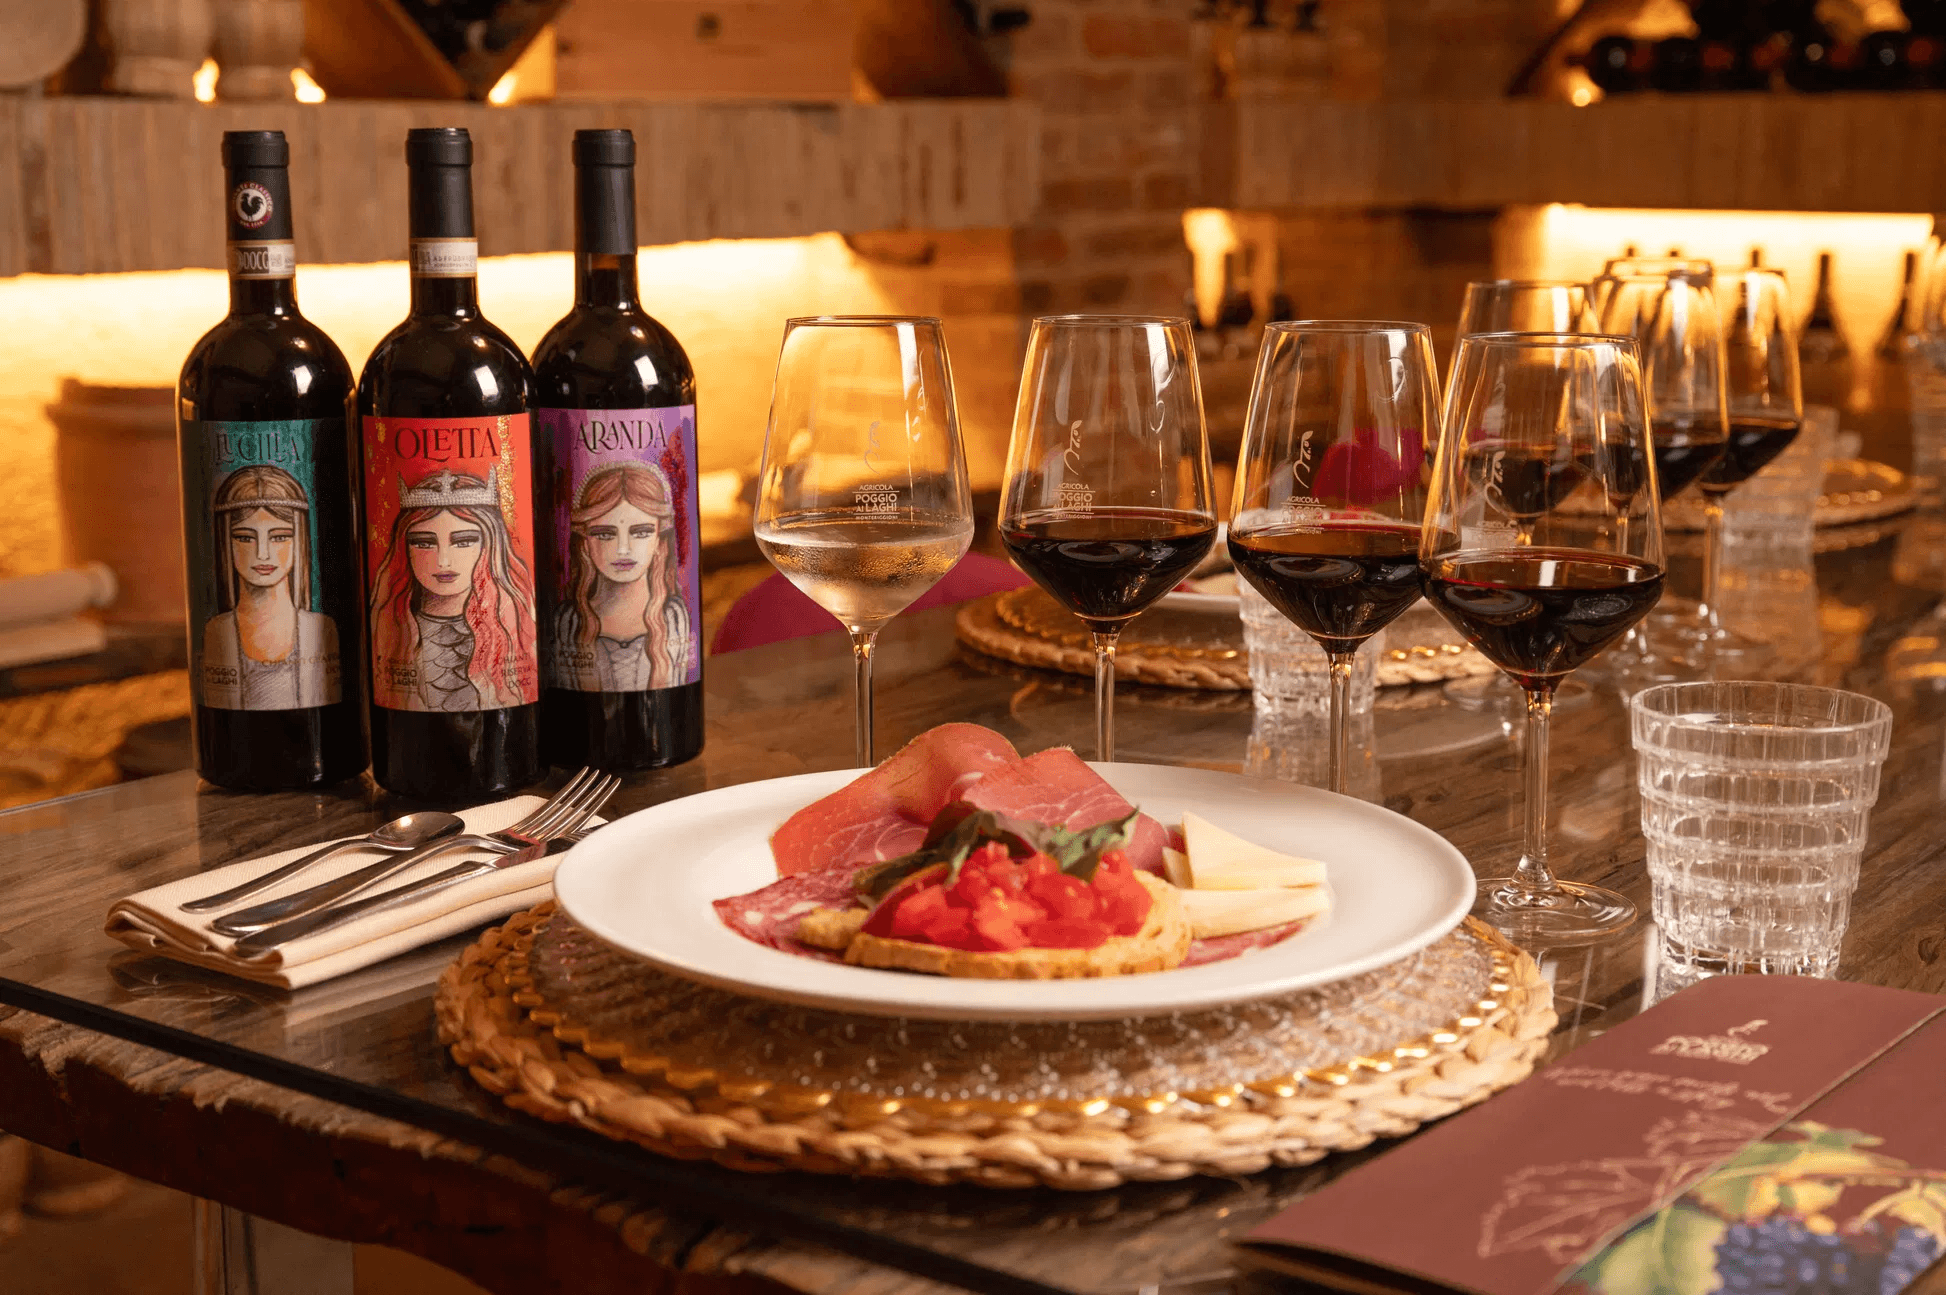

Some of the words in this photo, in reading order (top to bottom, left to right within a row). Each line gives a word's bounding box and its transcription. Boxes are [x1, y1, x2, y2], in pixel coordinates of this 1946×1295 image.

[574, 420, 668, 454] ARANDA
[395, 427, 498, 462] OLETTA
[1057, 482, 1089, 490] AGRICOLA
[855, 493, 898, 503] POGGIO
[865, 502, 897, 512] LAGHI
[1060, 500, 1092, 512] LAGHI
